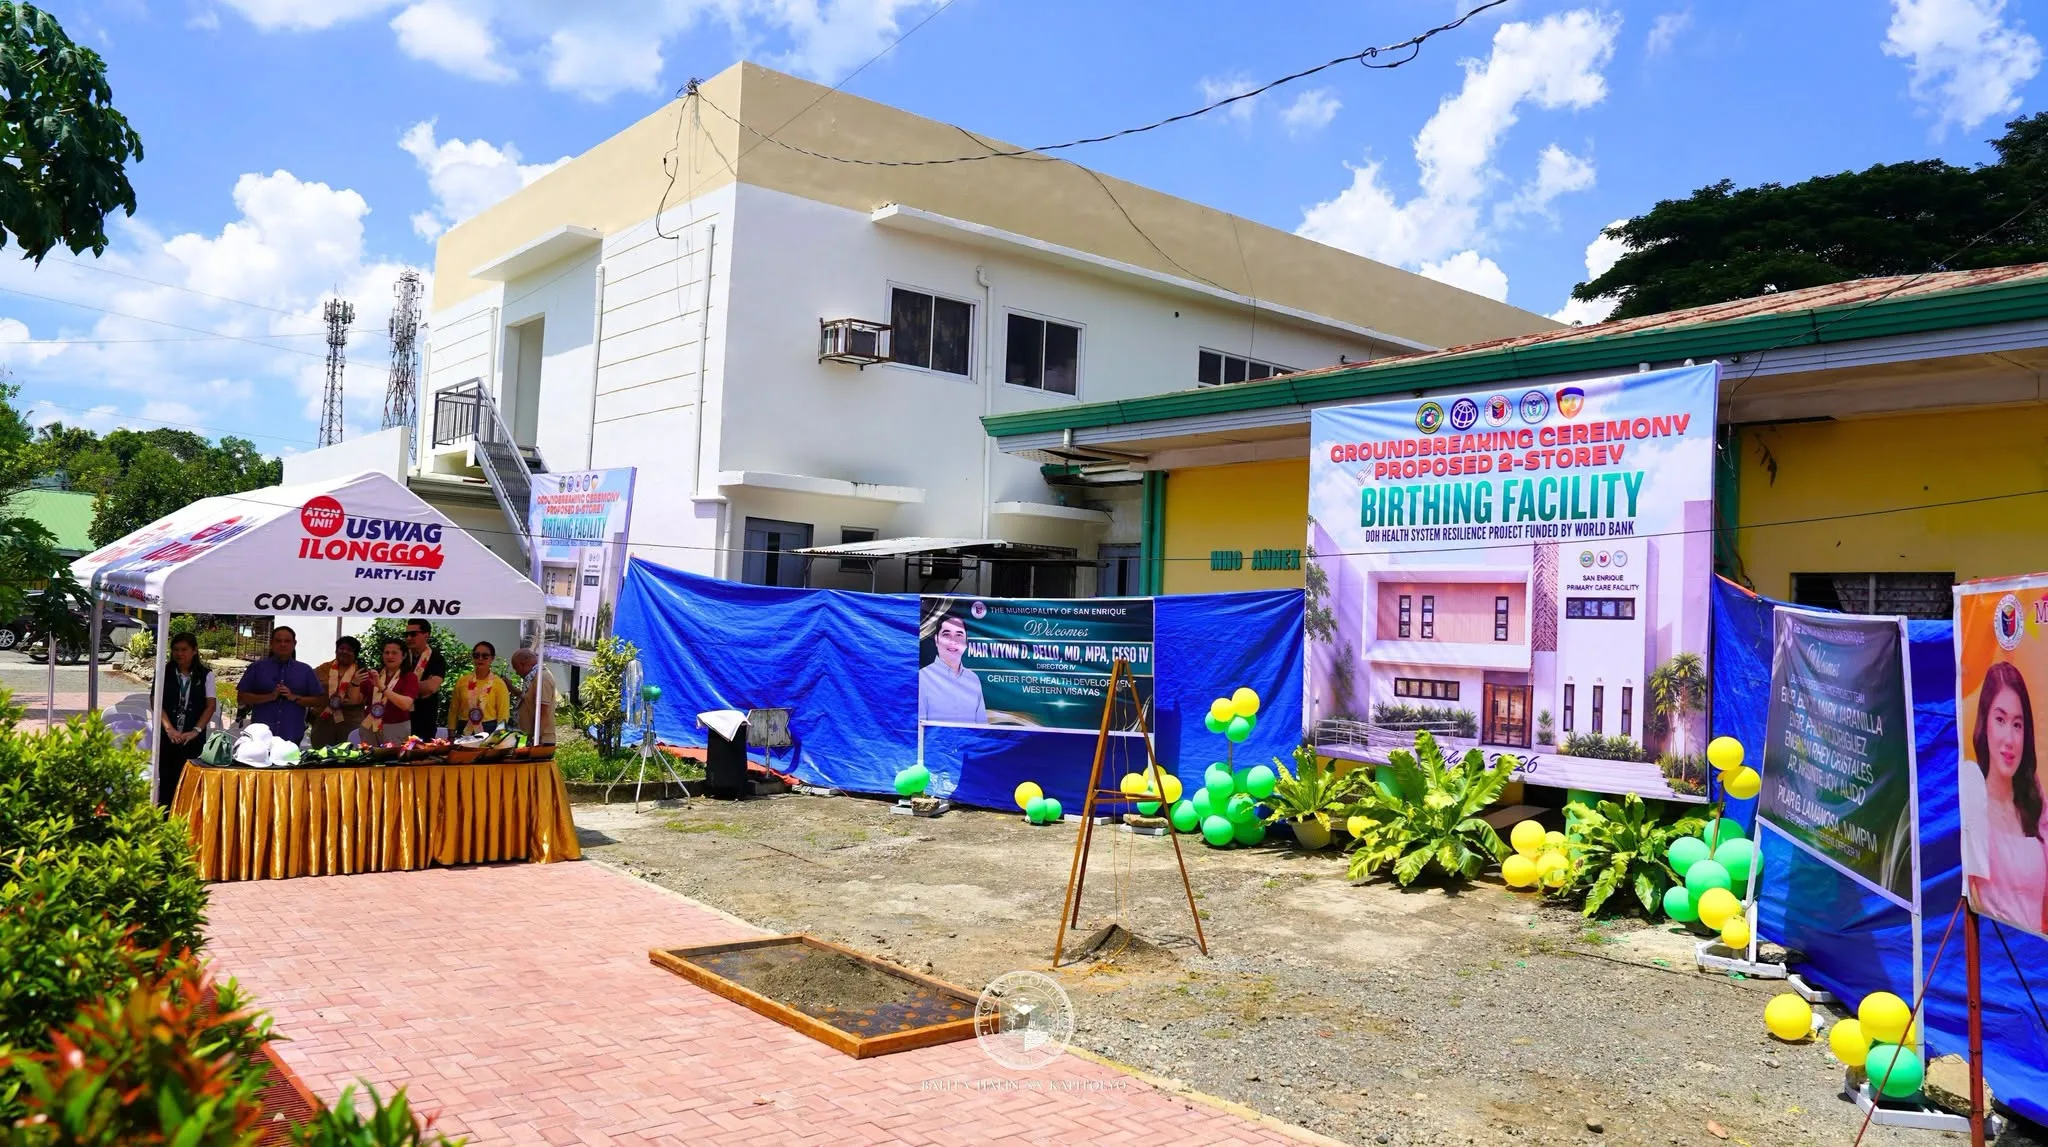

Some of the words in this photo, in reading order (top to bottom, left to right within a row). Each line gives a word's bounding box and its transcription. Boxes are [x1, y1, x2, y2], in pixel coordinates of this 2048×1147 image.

[1330, 428, 1534, 463] GROUNDBREAKING
[1538, 413, 1691, 448] CEREMONY
[1374, 454, 1493, 480] PROPOSED
[1498, 444, 1625, 473] 2-STOREY
[1360, 480, 1493, 527] BIRTHING
[1502, 471, 1645, 523] FACILITY
[304, 507, 340, 518] ATON
[309, 518, 333, 529] INI!
[346, 518, 443, 544] USWAG
[574, 516, 608, 539] FACILITY
[1365, 529, 1380, 543] DOH
[1382, 529, 1409, 542] HEALTH
[1411, 527, 1441, 541] SYSTEM
[1443, 526, 1487, 541] RESILIENCE
[1489, 525, 1522, 540] PROJECT
[1525, 523, 1558, 539] FUNDED
[1560, 523, 1572, 537] BY
[1575, 522, 1606, 537] WORLD
[1608, 521, 1635, 536] BANK
[299, 538, 438, 566] ILONGGO
[1251, 549, 1301, 571] ANNEX
[355, 567, 436, 582] PARTY-LIST
[1597, 574, 1624, 582] ENRIQUE
[254, 593, 334, 612] CONG.
[340, 596, 405, 614] JOJO
[409, 598, 461, 616] ANG
[990, 606, 1004, 614] THE
[1006, 607, 1059, 615] MUNICIPALITY
[1091, 608, 1127, 616] ENRIQUE
[1023, 618, 1089, 637] Welcomes
[967, 642, 988, 658] MAR
[989, 642, 1019, 659] WYNN
[1021, 644, 1030, 660] D.
[1032, 644, 1062, 663] BELLO,
[1064, 645, 1083, 663] MD,
[1085, 646, 1110, 664] MPA,
[1139, 647, 1149, 663] IV
[987, 674, 1020, 683] CENTER
[1021, 675, 1038, 684] FOR
[1040, 676, 1072, 686] HEALTH
[1073, 677, 1136, 688] DEVELOPEN
[1022, 685, 1062, 695] WESTERN
[1064, 687, 1100, 697] VISAYAS
[1831, 750, 1874, 784] CRISTALES
